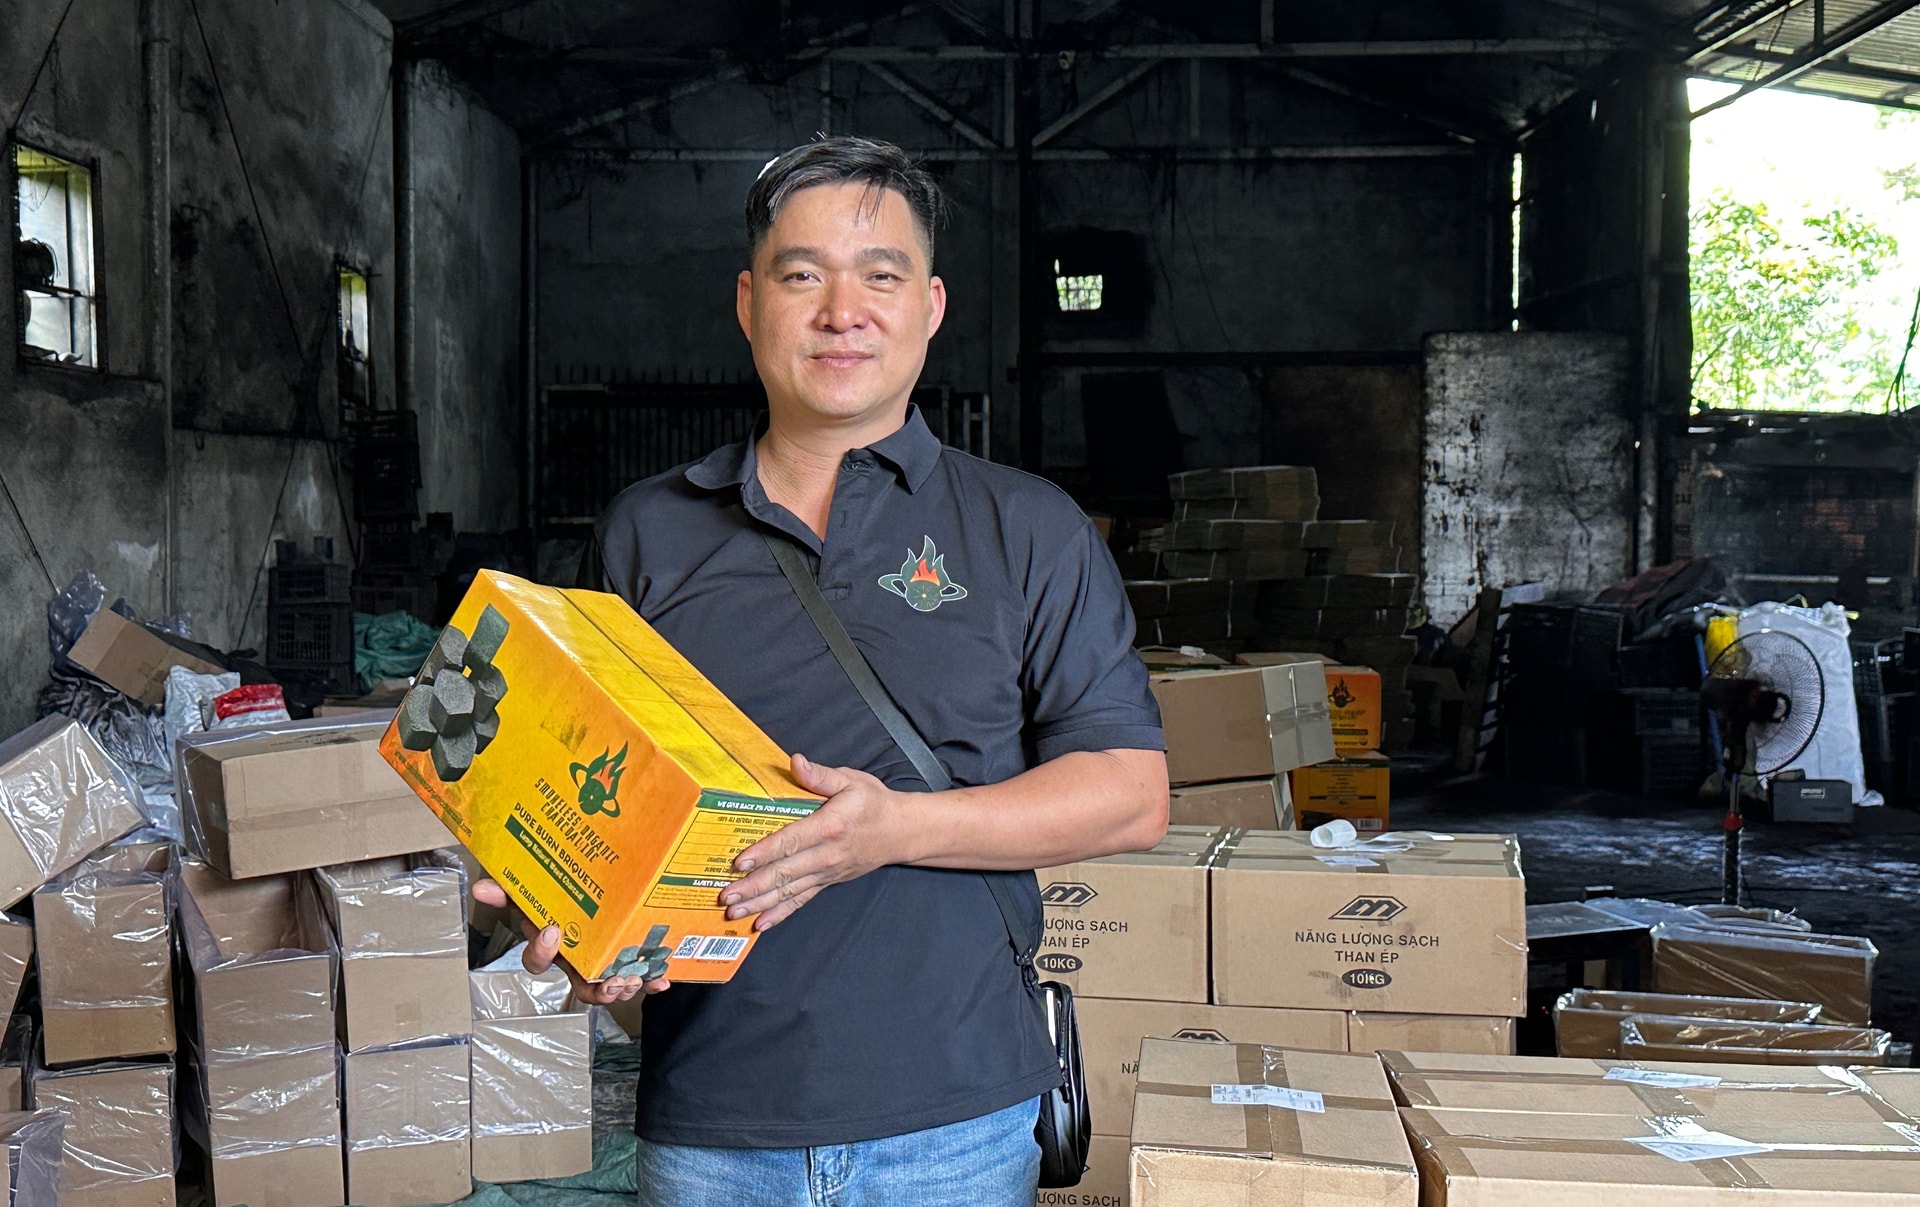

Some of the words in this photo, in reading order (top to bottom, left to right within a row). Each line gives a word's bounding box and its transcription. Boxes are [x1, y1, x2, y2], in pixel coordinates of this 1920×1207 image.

[535, 778, 581, 826] SMOKELESS
[581, 825, 620, 864] ORGANIC
[541, 802, 582, 847] CHARCOAL
[514, 802, 537, 828] PURE
[536, 825, 560, 852] BURN
[559, 849, 605, 900] BRIQUETTE
[502, 867, 520, 886] LUMP
[518, 884, 548, 920] CHARCOAL
[1045, 917, 1085, 932] ƯỢNG
[1090, 921, 1128, 934] SẠCH
[1041, 936, 1067, 947] HAN
[1072, 934, 1090, 948] ÉP
[1295, 929, 1337, 943] NĂNG
[1342, 932, 1394, 947] LƯỢNG
[1398, 935, 1440, 949] SẠCH
[1043, 958, 1076, 969] 10KG
[1335, 950, 1375, 963] THAN
[1381, 949, 1399, 963] ÉP
